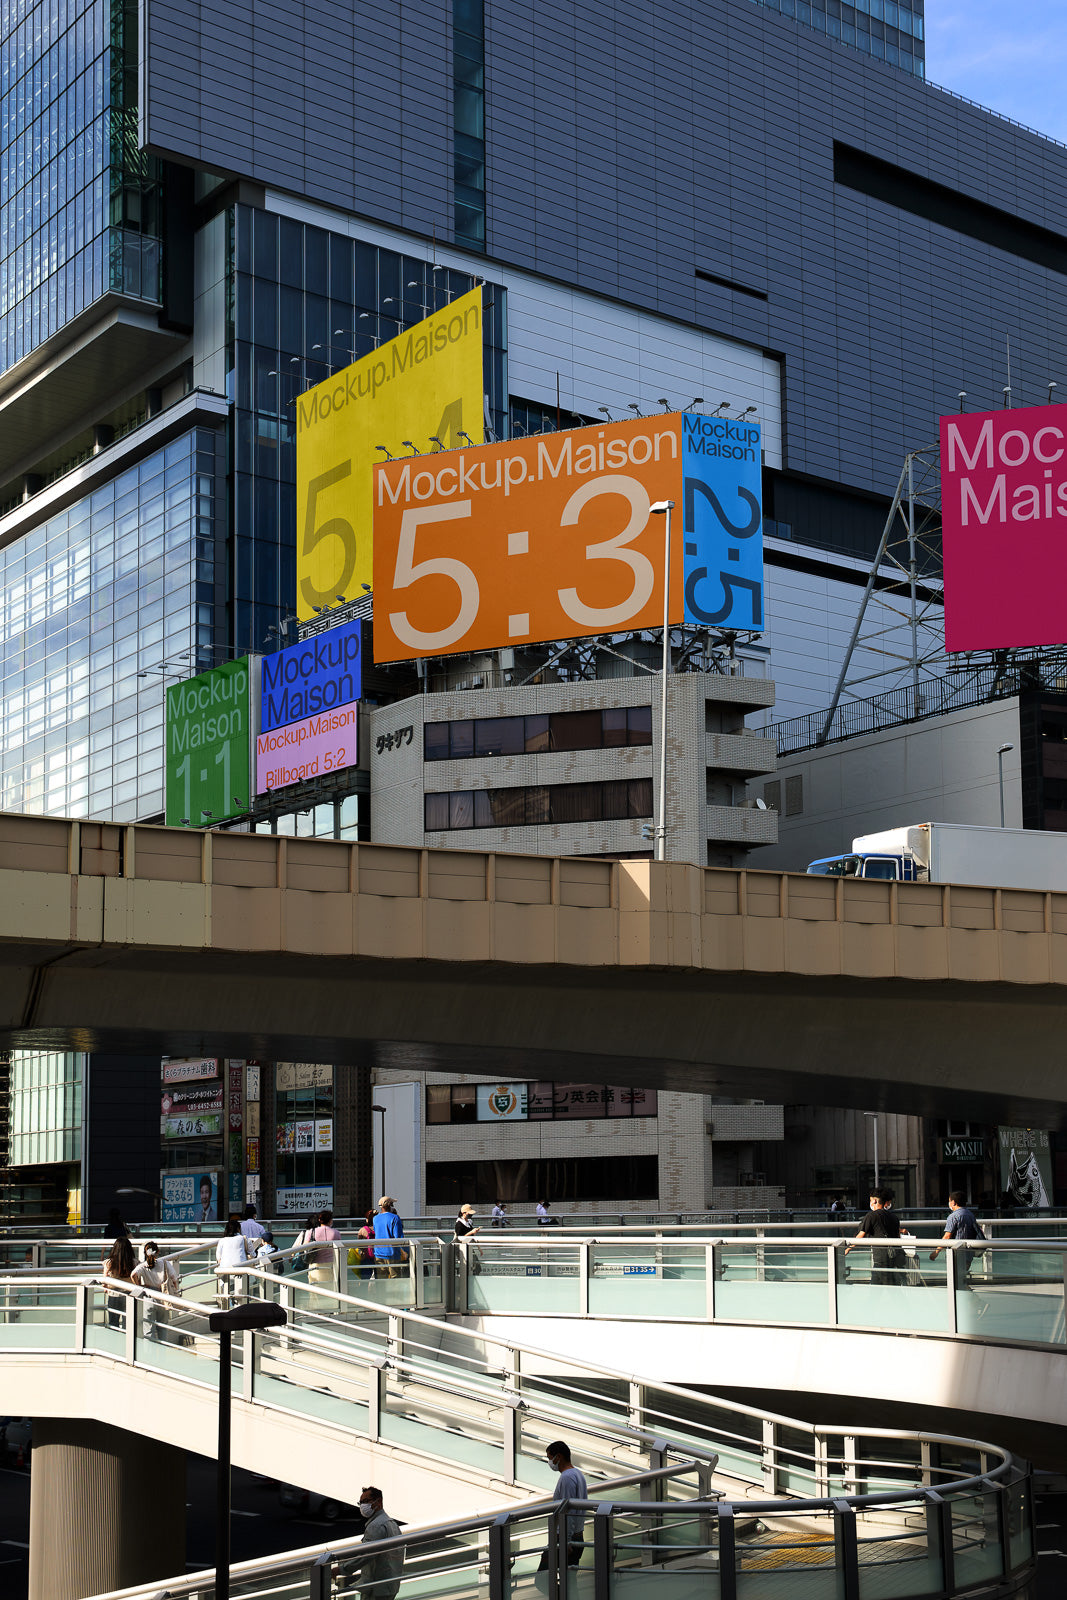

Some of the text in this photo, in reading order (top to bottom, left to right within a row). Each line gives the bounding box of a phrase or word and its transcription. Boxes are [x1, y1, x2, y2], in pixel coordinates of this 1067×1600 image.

[299, 304, 479, 433] Mockup.Maison
[684, 416, 760, 448] Mockup
[687, 435, 756, 463] Maison
[378, 430, 678, 507] Mockup.Maison
[388, 474, 655, 650] 5:3
[684, 476, 763, 626] 2:5
[263, 633, 360, 694] Mockup
[168, 670, 247, 722] Mockup
[267, 672, 354, 728] Maison
[172, 708, 242, 755] Maison
[257, 709, 356, 756] Mockup.Maison
[265, 747, 347, 789] Billboard 5:2
[176, 1118, 204, 1136] 森の香
[945, 1141, 983, 1156] SANSUI
[166, 1189, 193, 1202] 売るなら
